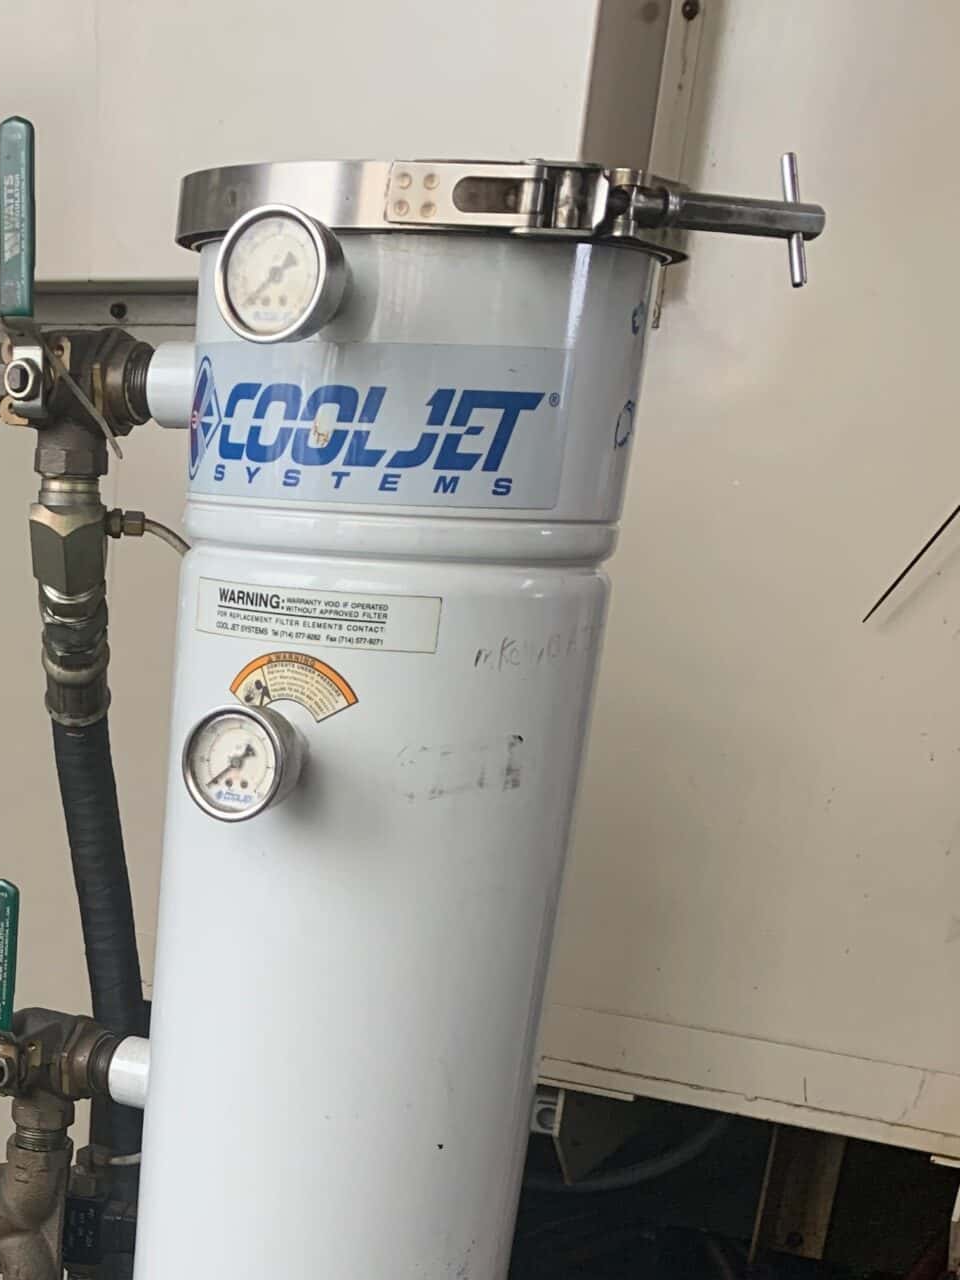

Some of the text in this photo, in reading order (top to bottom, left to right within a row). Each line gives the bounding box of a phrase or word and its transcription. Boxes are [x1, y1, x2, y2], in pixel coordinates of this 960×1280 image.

[3, 174, 15, 230] WATTS
[218, 383, 546, 472] COOLJET
[213, 464, 513, 496] SYSTEMS
[218, 587, 286, 609] WARNING:
[351, 602, 389, 612] OPERATED
[229, 611, 273, 623] REPLACEMENT
[275, 617, 300, 626] FILTER
[302, 621, 343, 631] ELEMENTS
[286, 606, 388, 620] WITHOUT APPROVED FILTER
[241, 624, 269, 635] SYSTEMS
